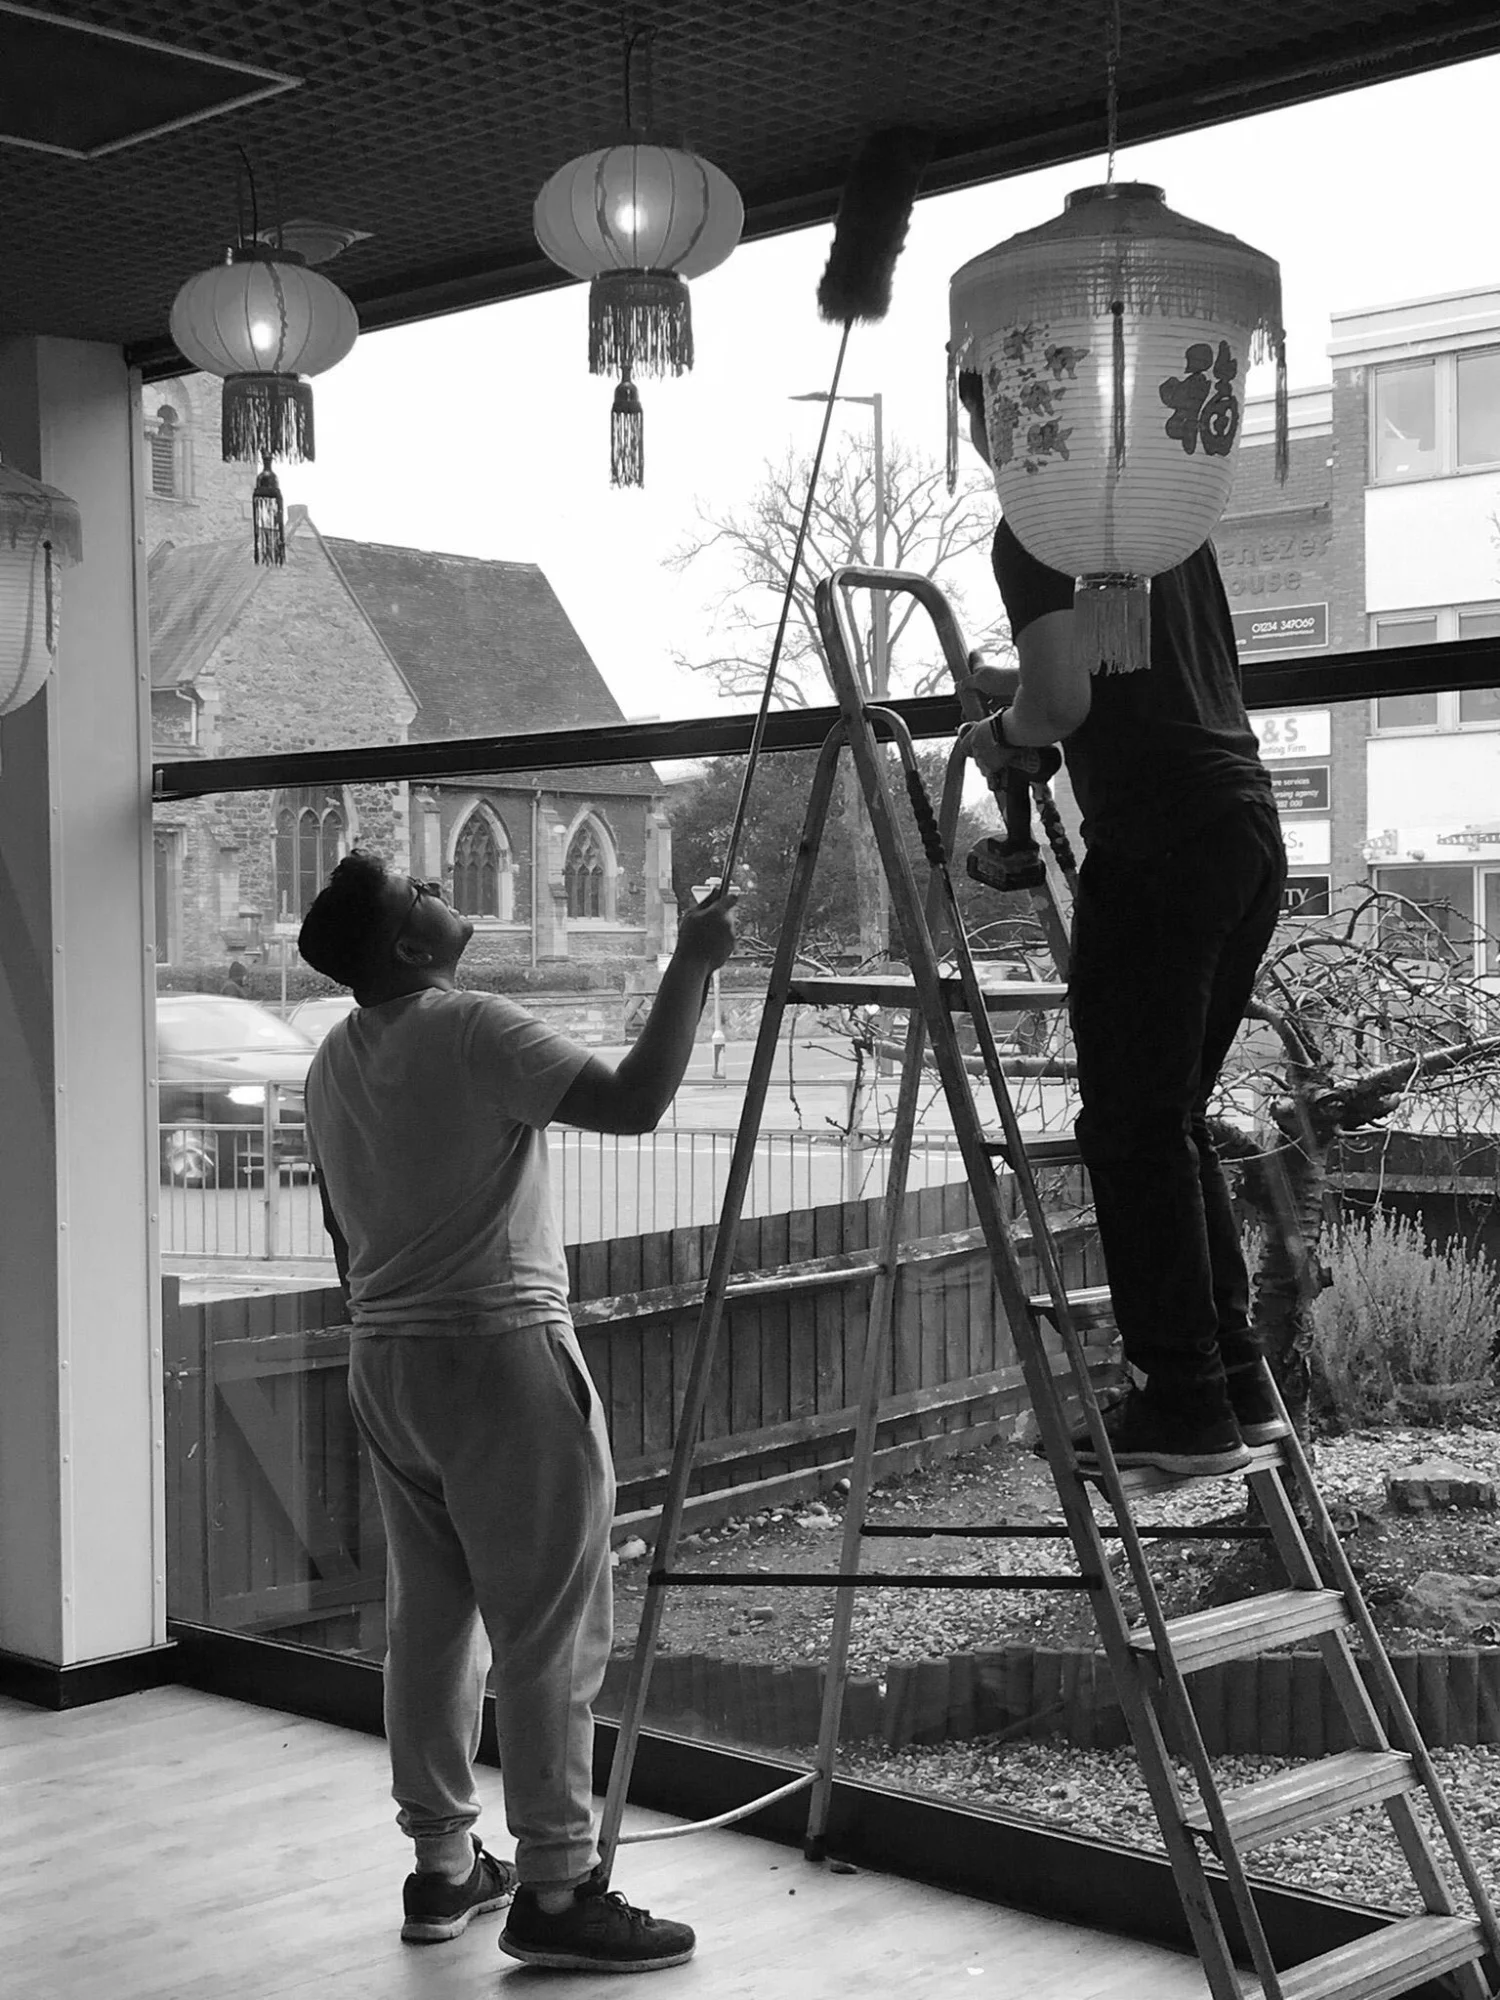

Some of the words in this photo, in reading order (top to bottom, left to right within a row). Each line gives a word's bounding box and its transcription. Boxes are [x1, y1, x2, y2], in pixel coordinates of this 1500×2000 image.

[1251, 622, 1277, 633] 01234
[1262, 720, 1279, 743] &
[1284, 718, 1298, 742] S
